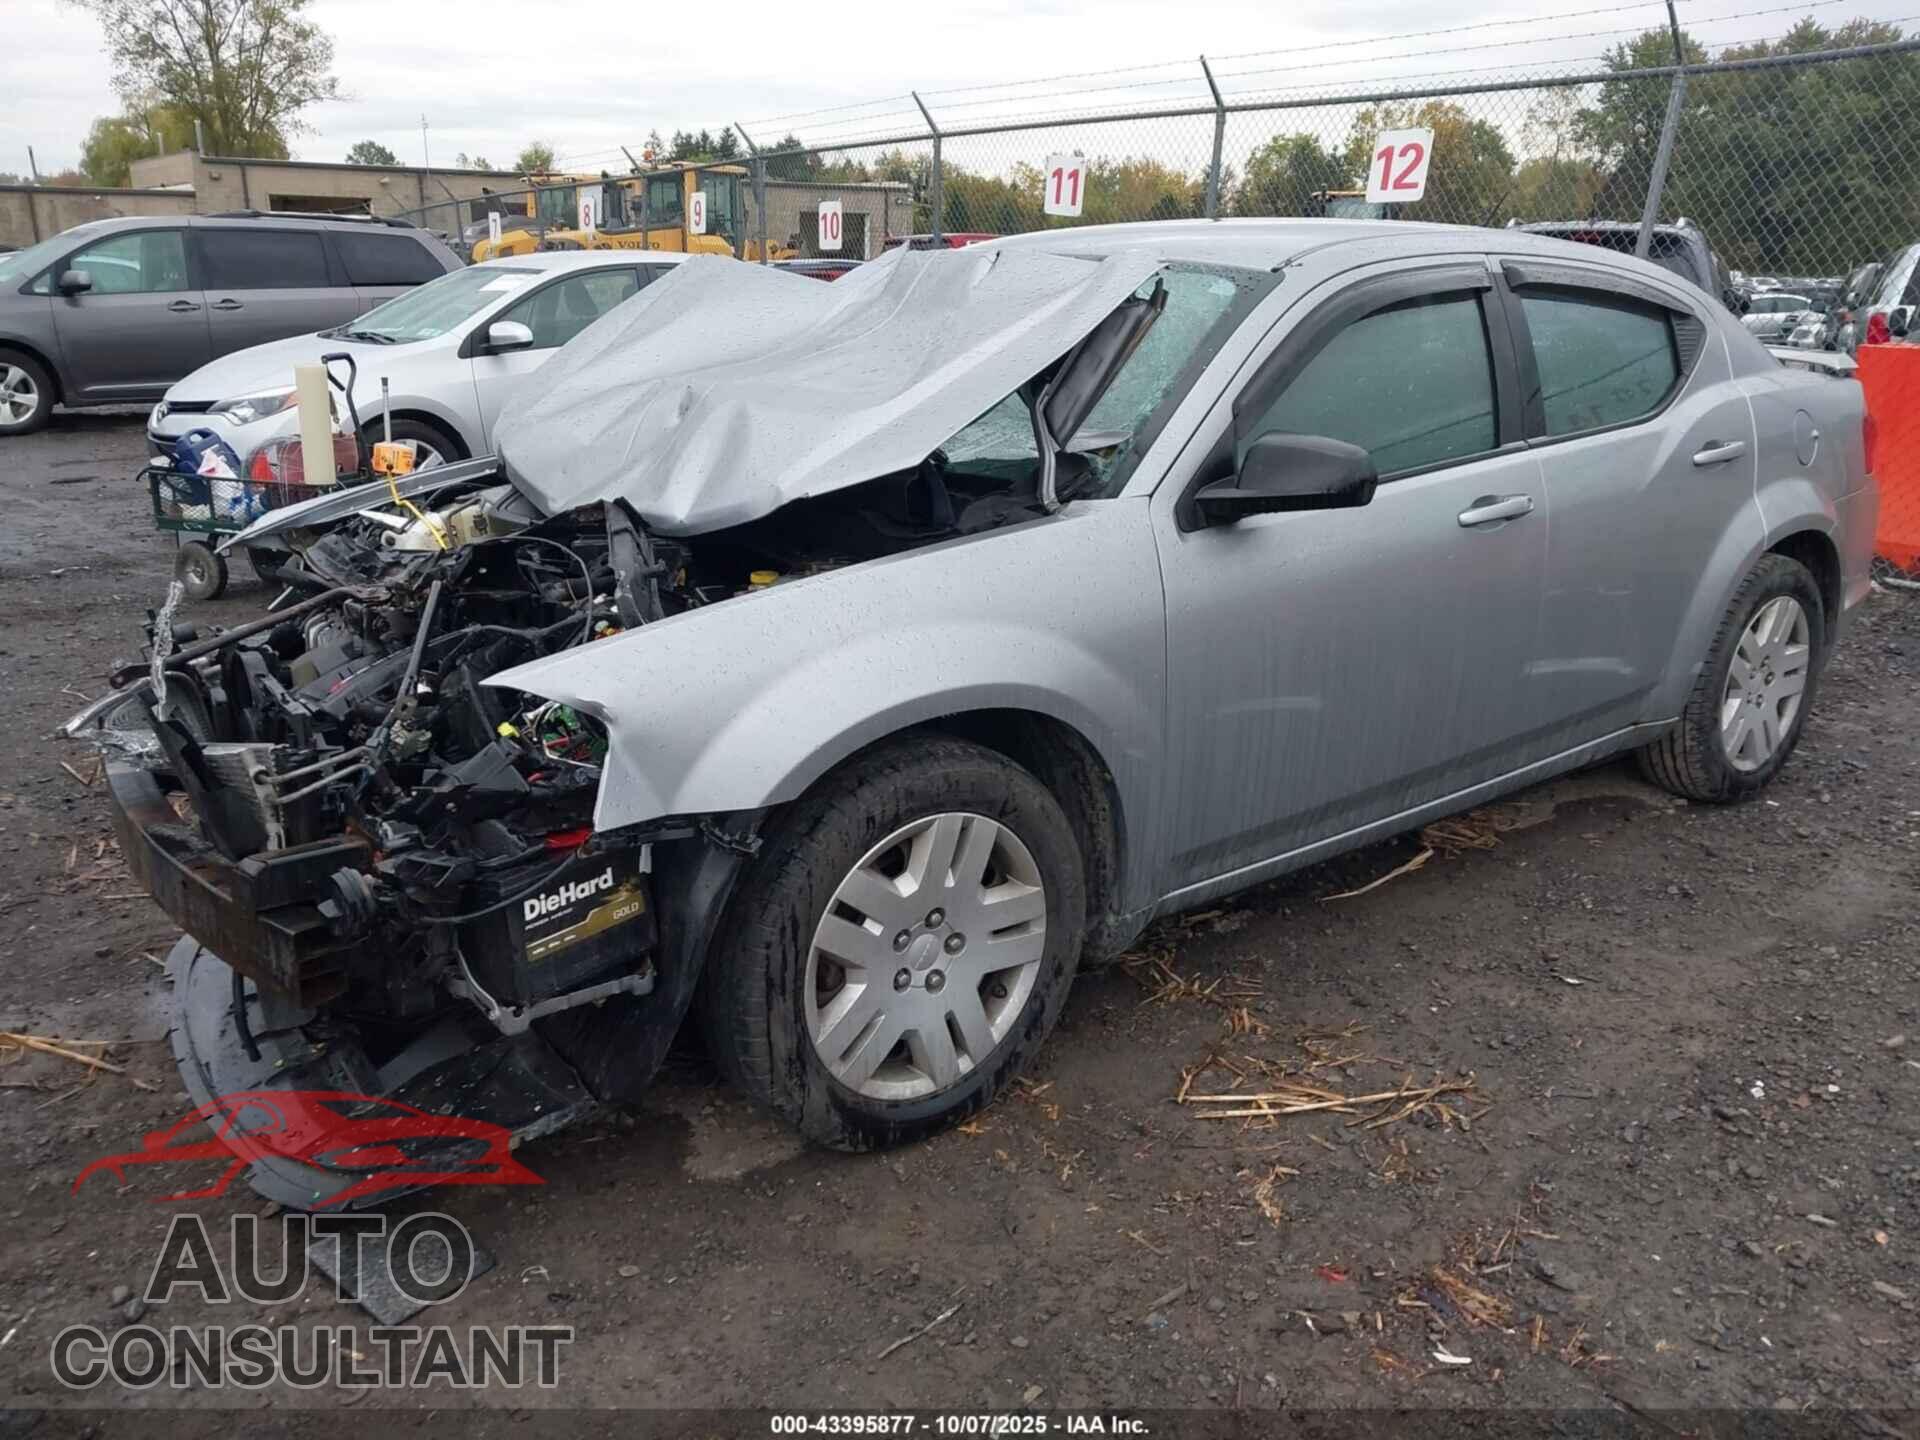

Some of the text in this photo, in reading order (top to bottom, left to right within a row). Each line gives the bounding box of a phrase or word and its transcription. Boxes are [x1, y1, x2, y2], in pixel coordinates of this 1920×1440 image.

[1376, 143, 1425, 191] 12
[1051, 167, 1080, 206] 11
[583, 204, 591, 227] 8
[694, 201, 702, 227] 9
[821, 211, 840, 240] 10
[491, 218, 498, 240] 7
[617, 240, 661, 249] VOLO
[523, 866, 614, 921] DieHard
[613, 901, 639, 920] GOLD
